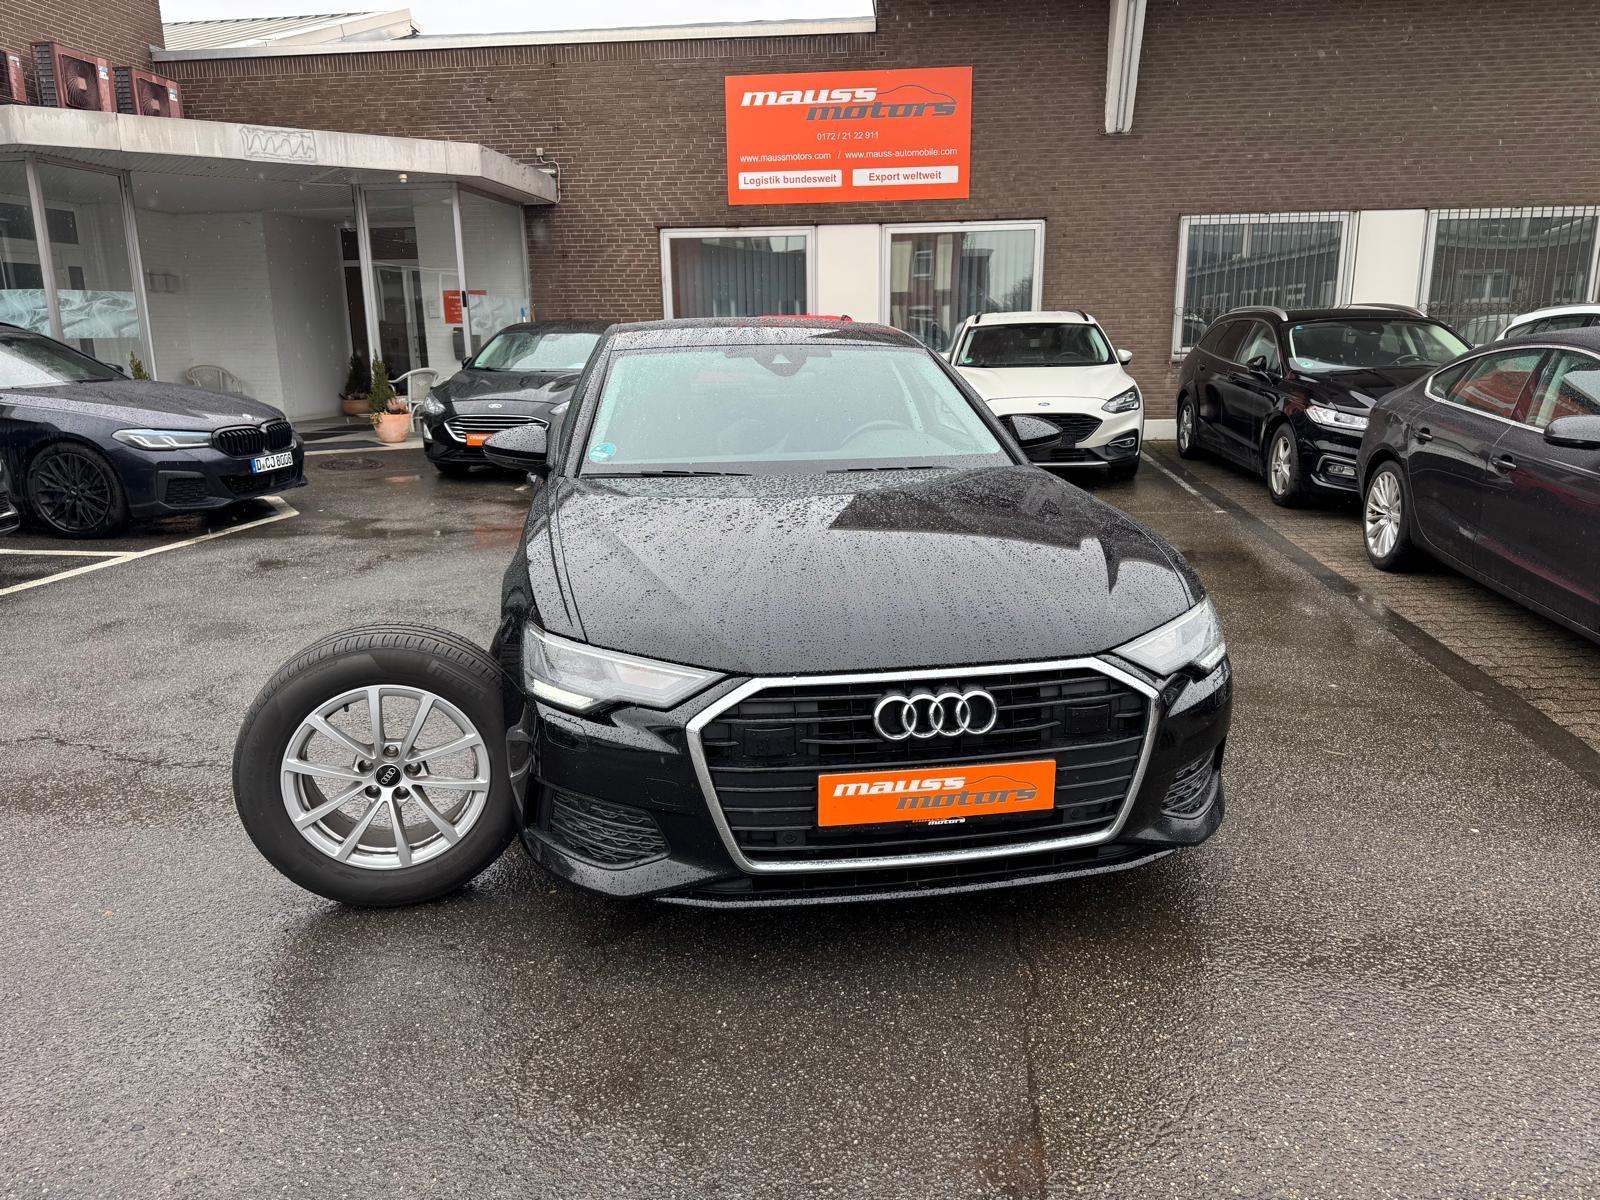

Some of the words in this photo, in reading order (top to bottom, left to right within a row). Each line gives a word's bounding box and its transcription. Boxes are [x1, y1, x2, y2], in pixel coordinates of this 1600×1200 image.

[741, 87, 877, 106] mauss
[806, 101, 956, 121] motors
[816, 132, 836, 141] 0172
[842, 131, 851, 140] 21
[854, 131, 864, 140] 22
[865, 131, 879, 139] 911
[740, 151, 831, 163] www.maussmotors.com
[845, 147, 958, 159] www.mauss-automobile.com
[743, 174, 781, 186] Logistik
[783, 173, 837, 184] bundesweit
[868, 171, 900, 183] Export
[902, 170, 942, 181] weltweit
[256, 459, 262, 471] D
[833, 776, 966, 797] mauss
[896, 788, 1037, 810] motors
